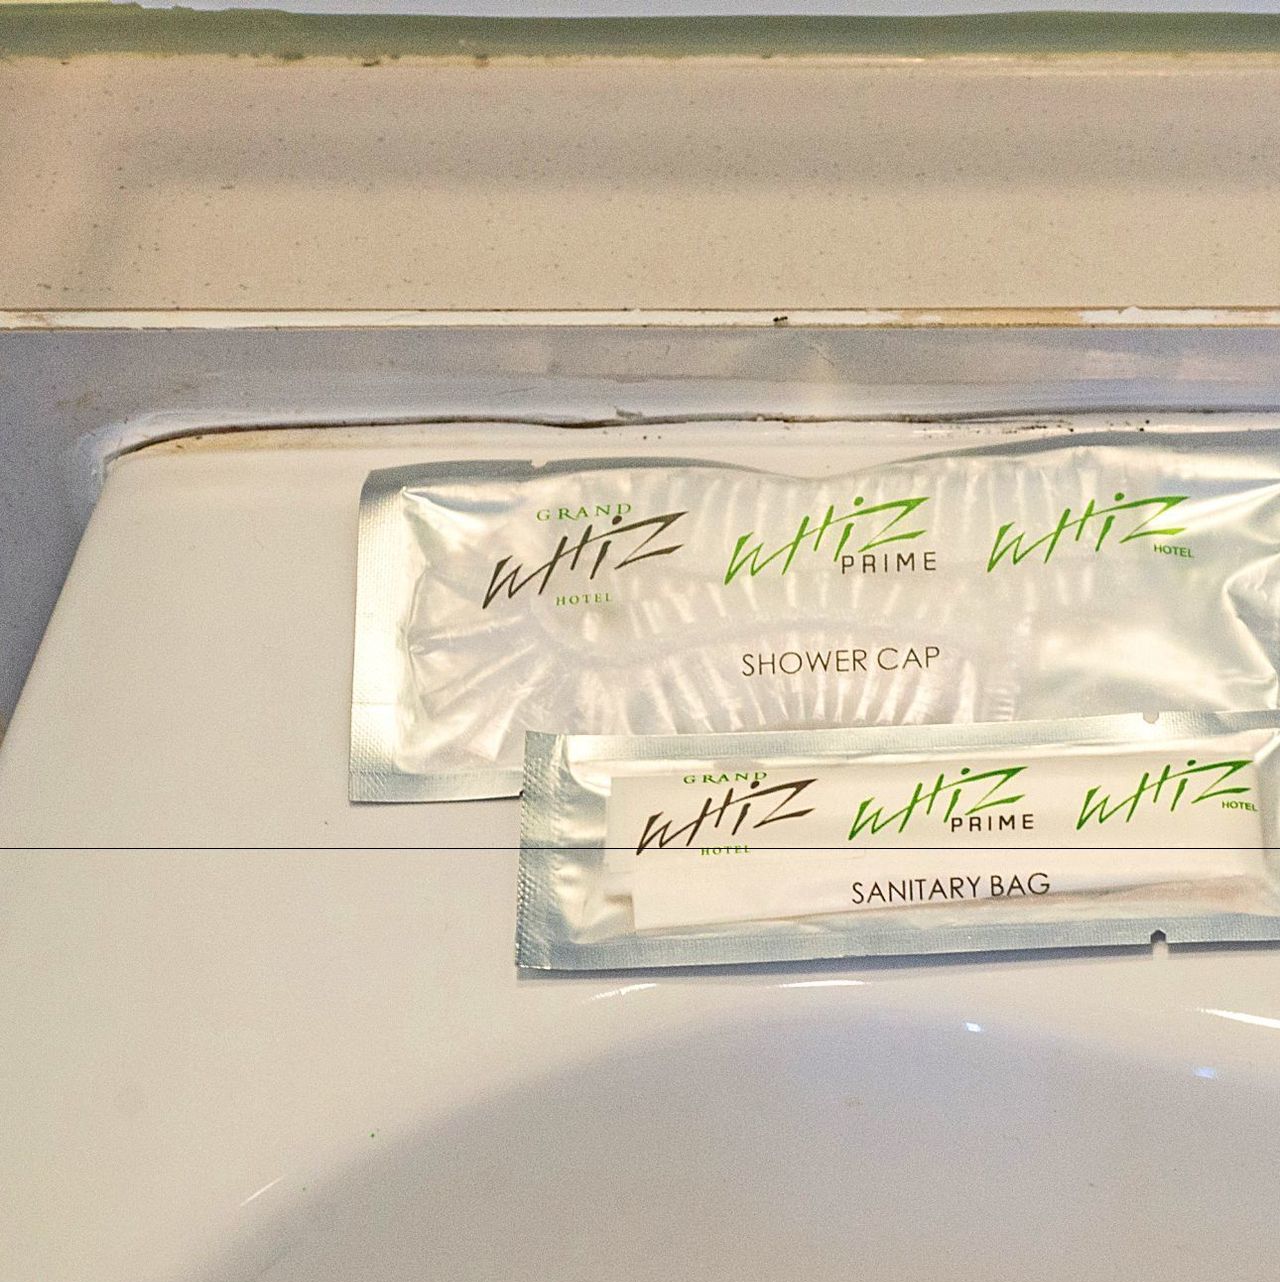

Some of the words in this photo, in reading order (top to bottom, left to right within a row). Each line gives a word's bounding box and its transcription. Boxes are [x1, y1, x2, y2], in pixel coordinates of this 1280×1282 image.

[537, 502, 632, 522] GRAND
[1153, 543, 1195, 559] HOTEL
[841, 551, 937, 576] PRIME
[555, 592, 613, 607] HOTEL
[742, 648, 868, 677] SHOWER
[877, 646, 940, 670] CAP
[683, 771, 768, 785] GRAND
[1221, 800, 1258, 813] HOTEL
[950, 813, 1035, 833] PRIME
[700, 844, 750, 856] HOTEL
[851, 875, 981, 905] SANITARY
[990, 872, 1051, 896] BAG
